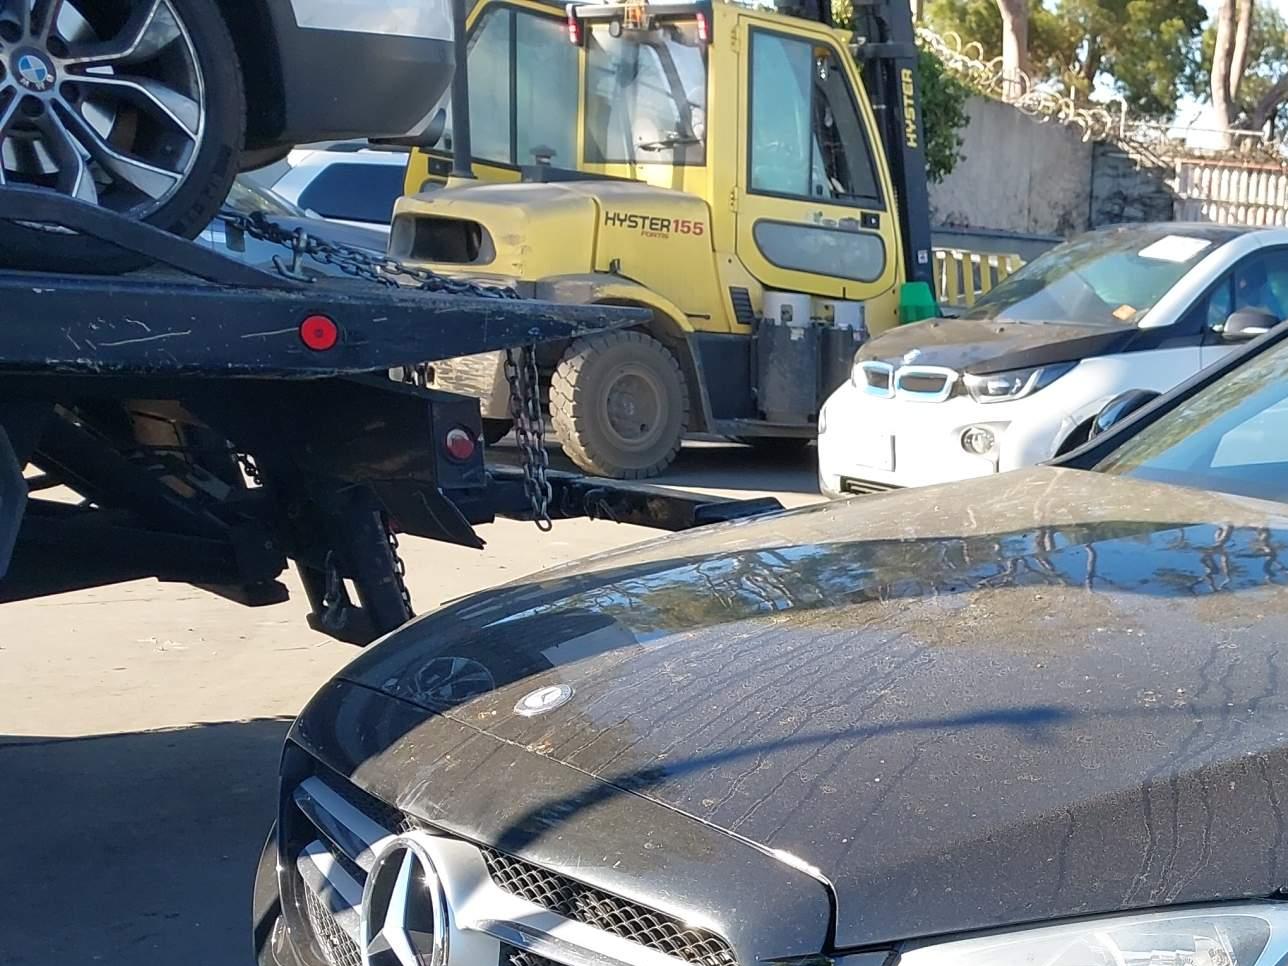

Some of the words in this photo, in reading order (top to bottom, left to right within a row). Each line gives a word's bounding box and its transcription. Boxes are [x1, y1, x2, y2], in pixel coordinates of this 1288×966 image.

[901, 68, 918, 149] HYSTER
[604, 211, 671, 232] HYSTER
[673, 219, 704, 236] 155
